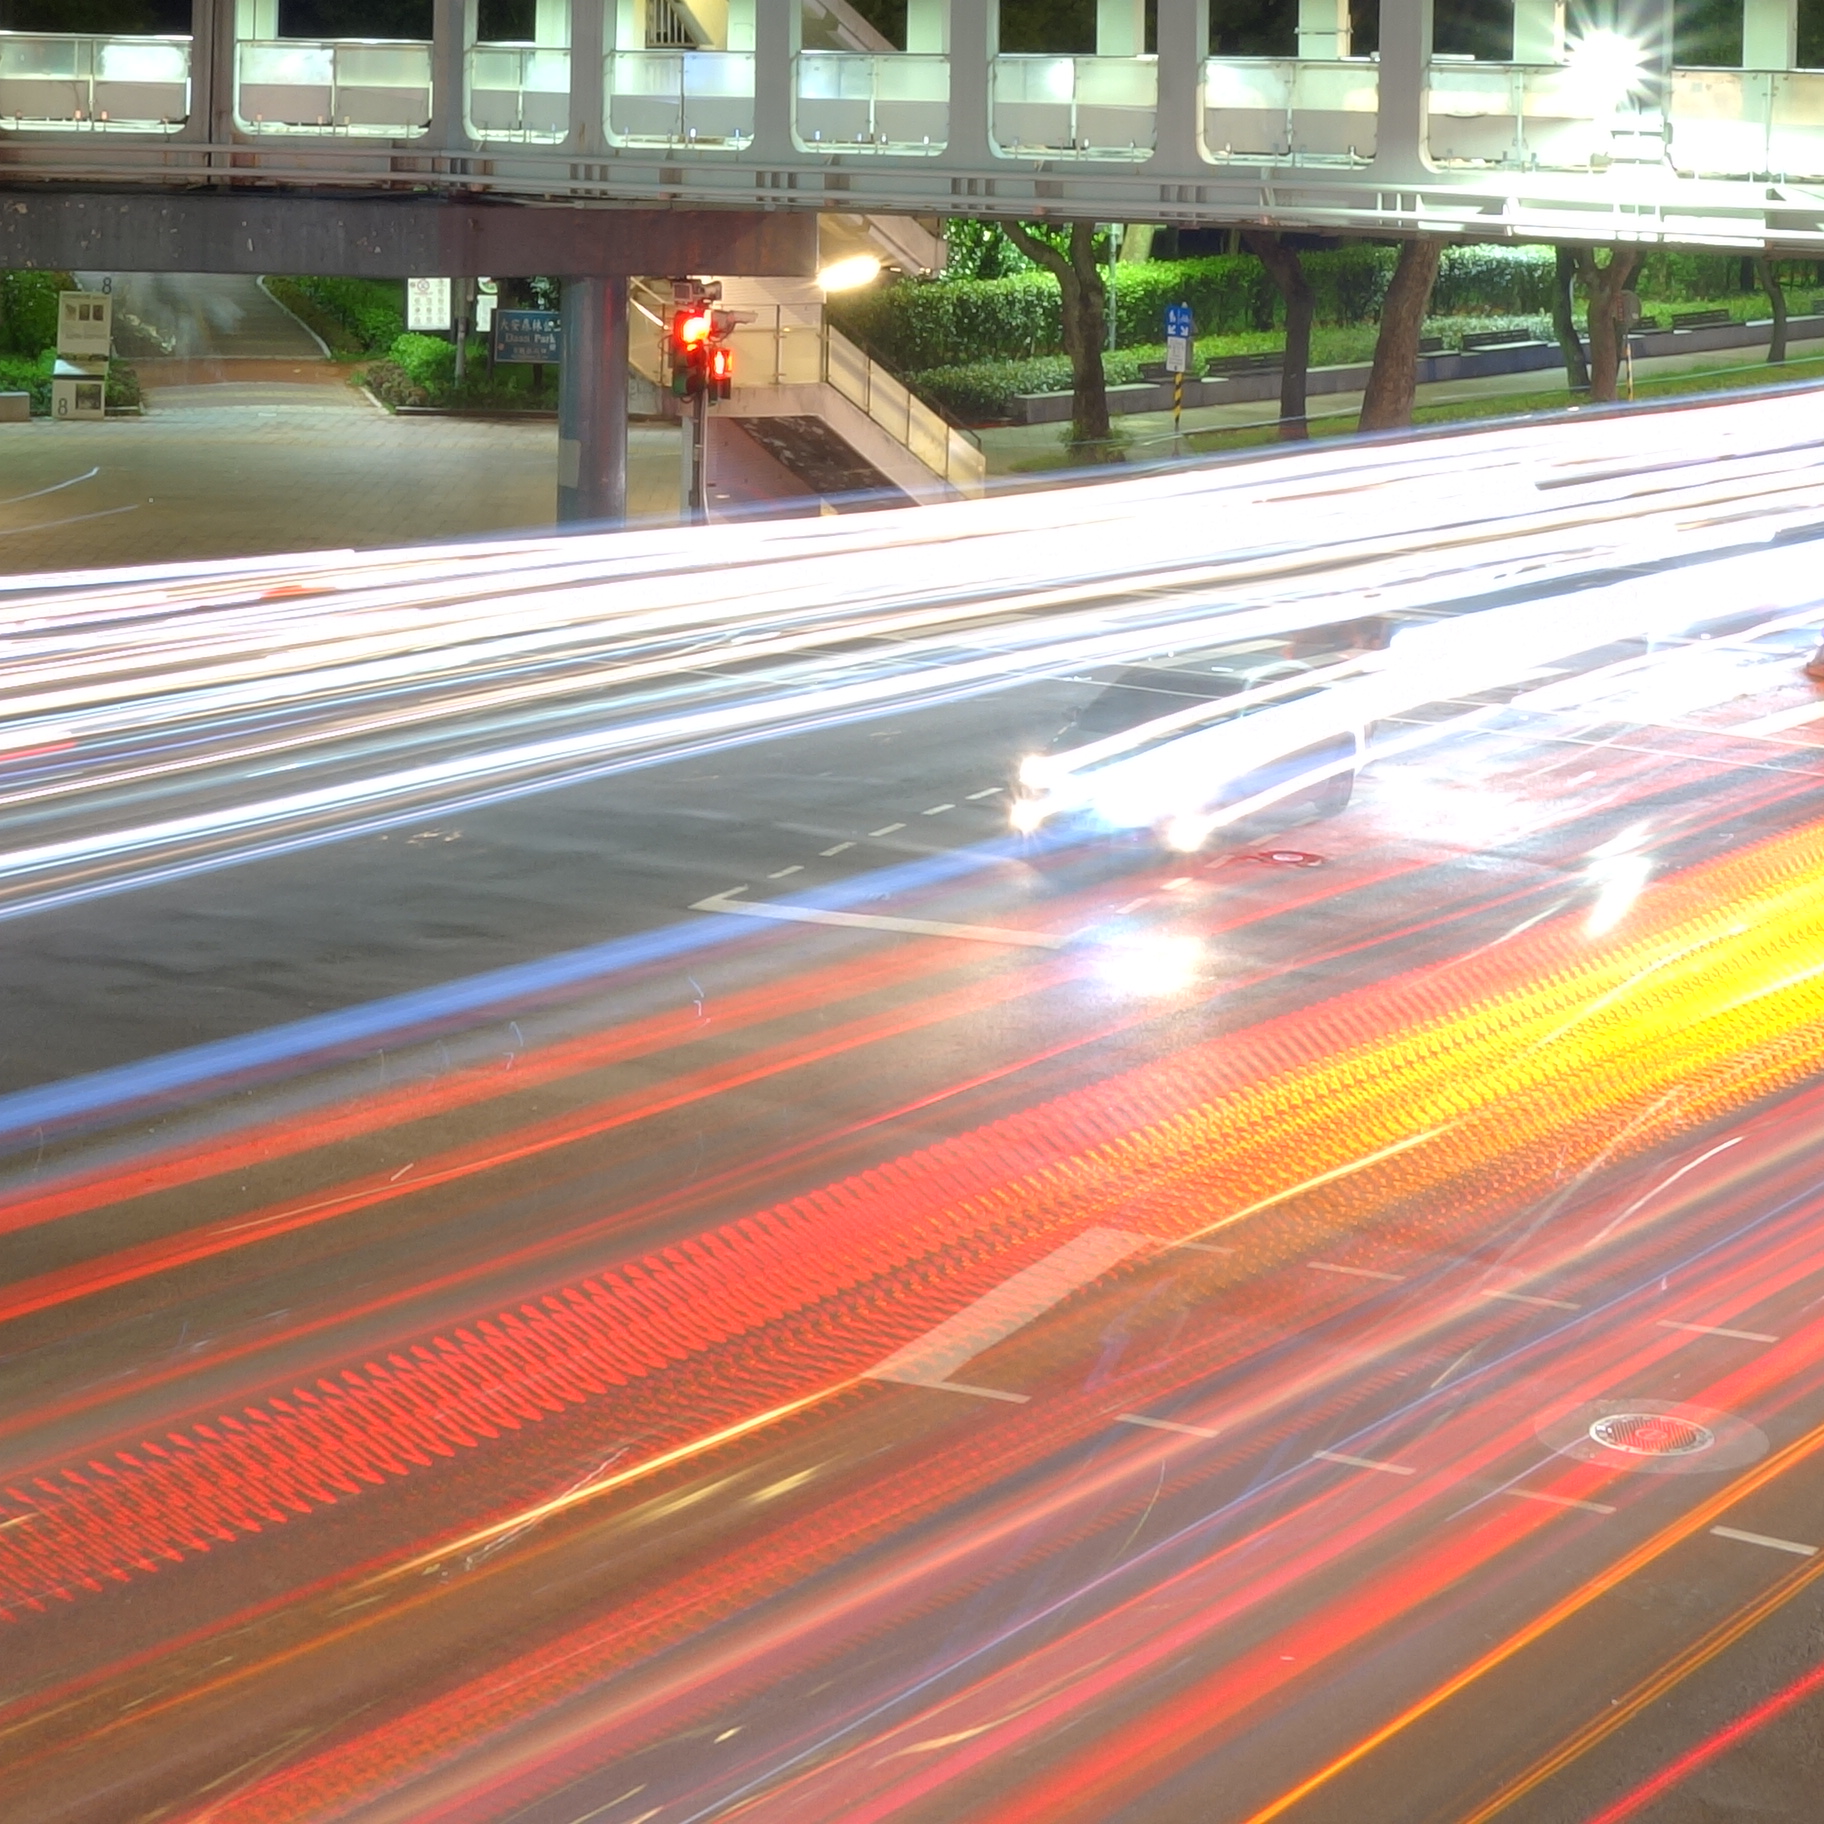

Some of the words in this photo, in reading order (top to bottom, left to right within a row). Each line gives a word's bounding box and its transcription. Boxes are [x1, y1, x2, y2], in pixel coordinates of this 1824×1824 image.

[102, 277, 112, 295] 8
[534, 333, 556, 344] Park
[58, 398, 68, 416] 8
